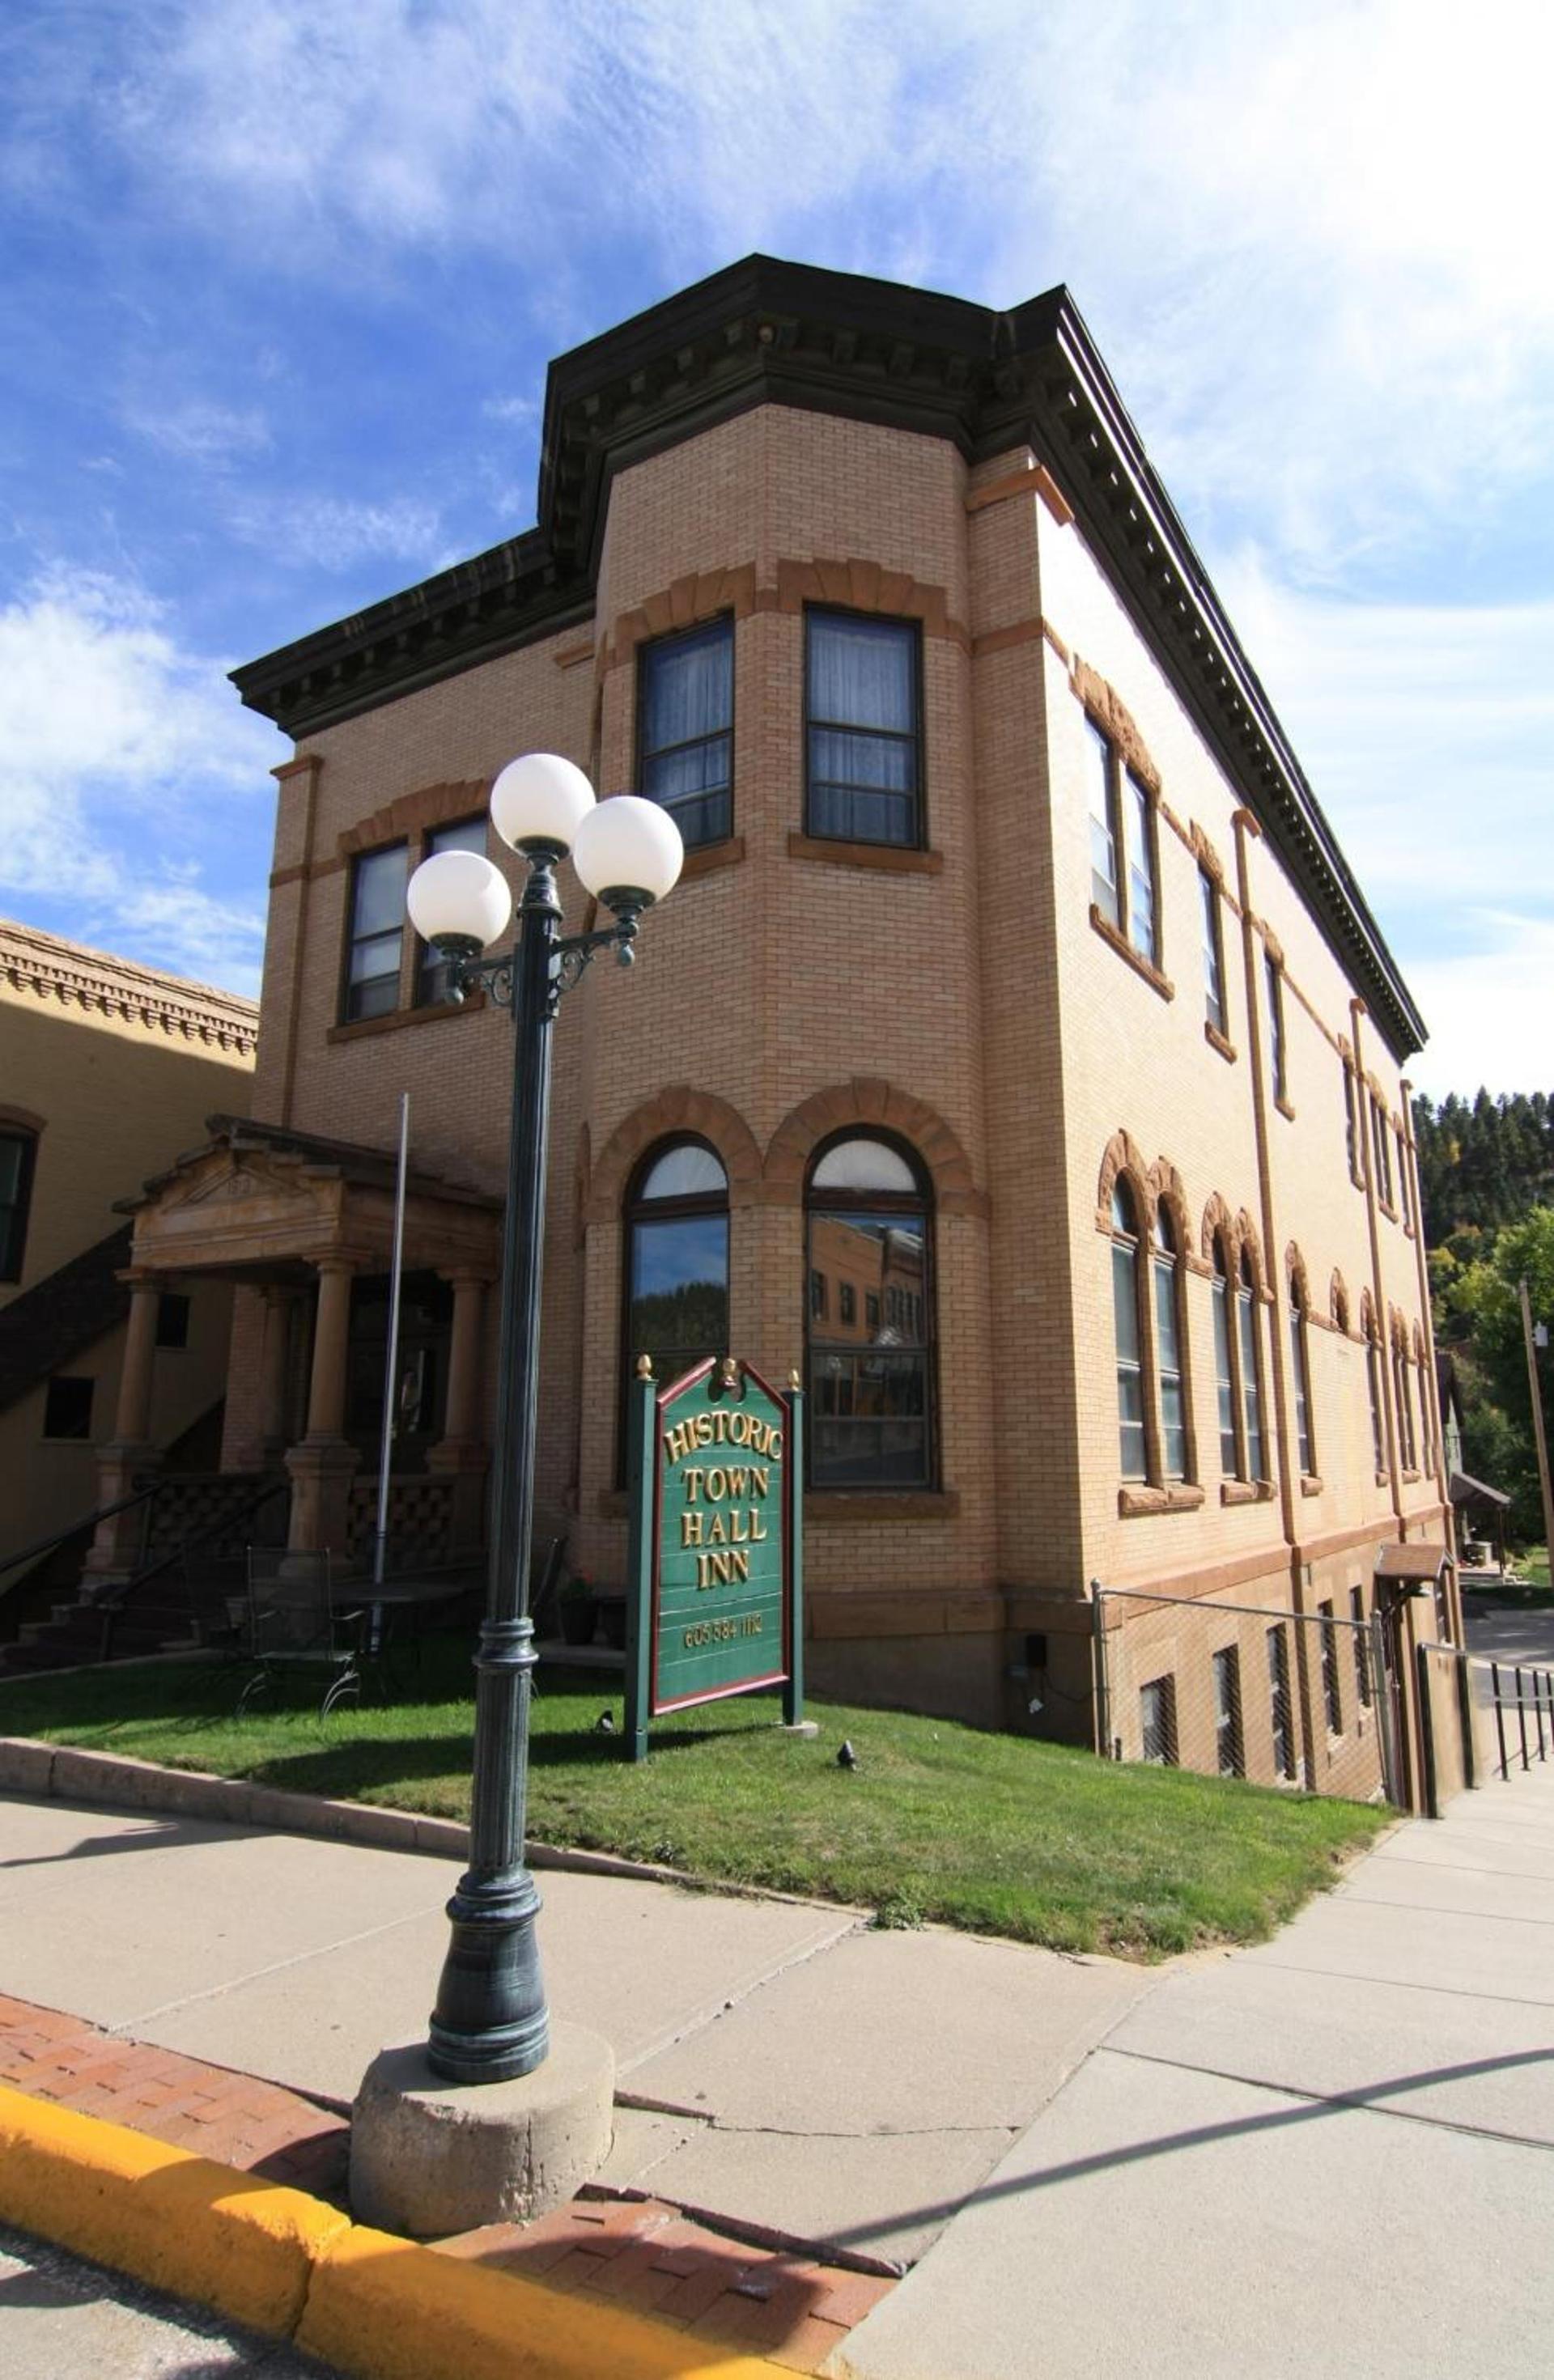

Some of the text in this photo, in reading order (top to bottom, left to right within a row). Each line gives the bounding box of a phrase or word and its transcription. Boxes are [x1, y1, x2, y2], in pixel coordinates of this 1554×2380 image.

[664, 1411, 783, 1465] HISTORIC
[682, 1467, 770, 1503] TOWN
[681, 1508, 767, 1547] HALL
[697, 1550, 749, 1589] INN
[685, 1623, 711, 1648] 605
